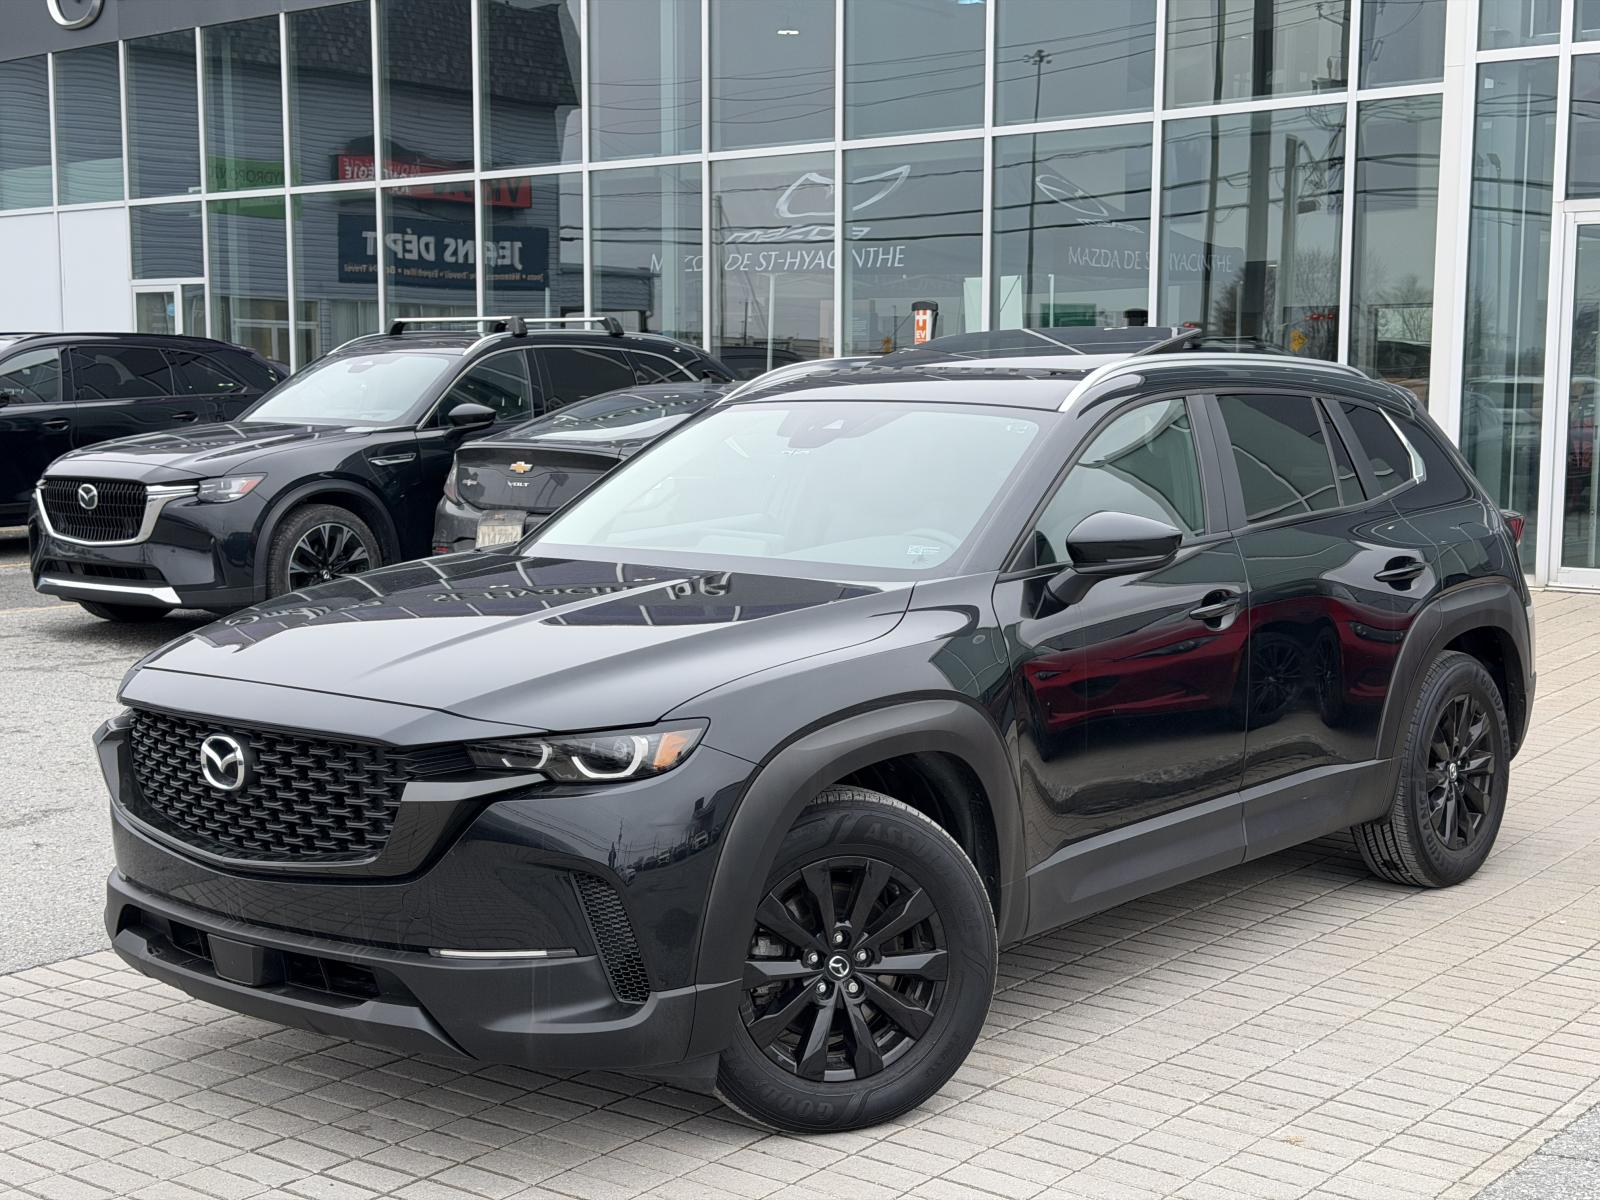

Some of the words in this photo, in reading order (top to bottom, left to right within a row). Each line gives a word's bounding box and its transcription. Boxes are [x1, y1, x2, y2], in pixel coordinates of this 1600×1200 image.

[724, 252, 753, 272] DE
[755, 245, 906, 271] ST-HYACNTHE
[1068, 246, 1121, 269] MAZDA
[1123, 250, 1142, 270] DE
[506, 480, 530, 488] VOLT
